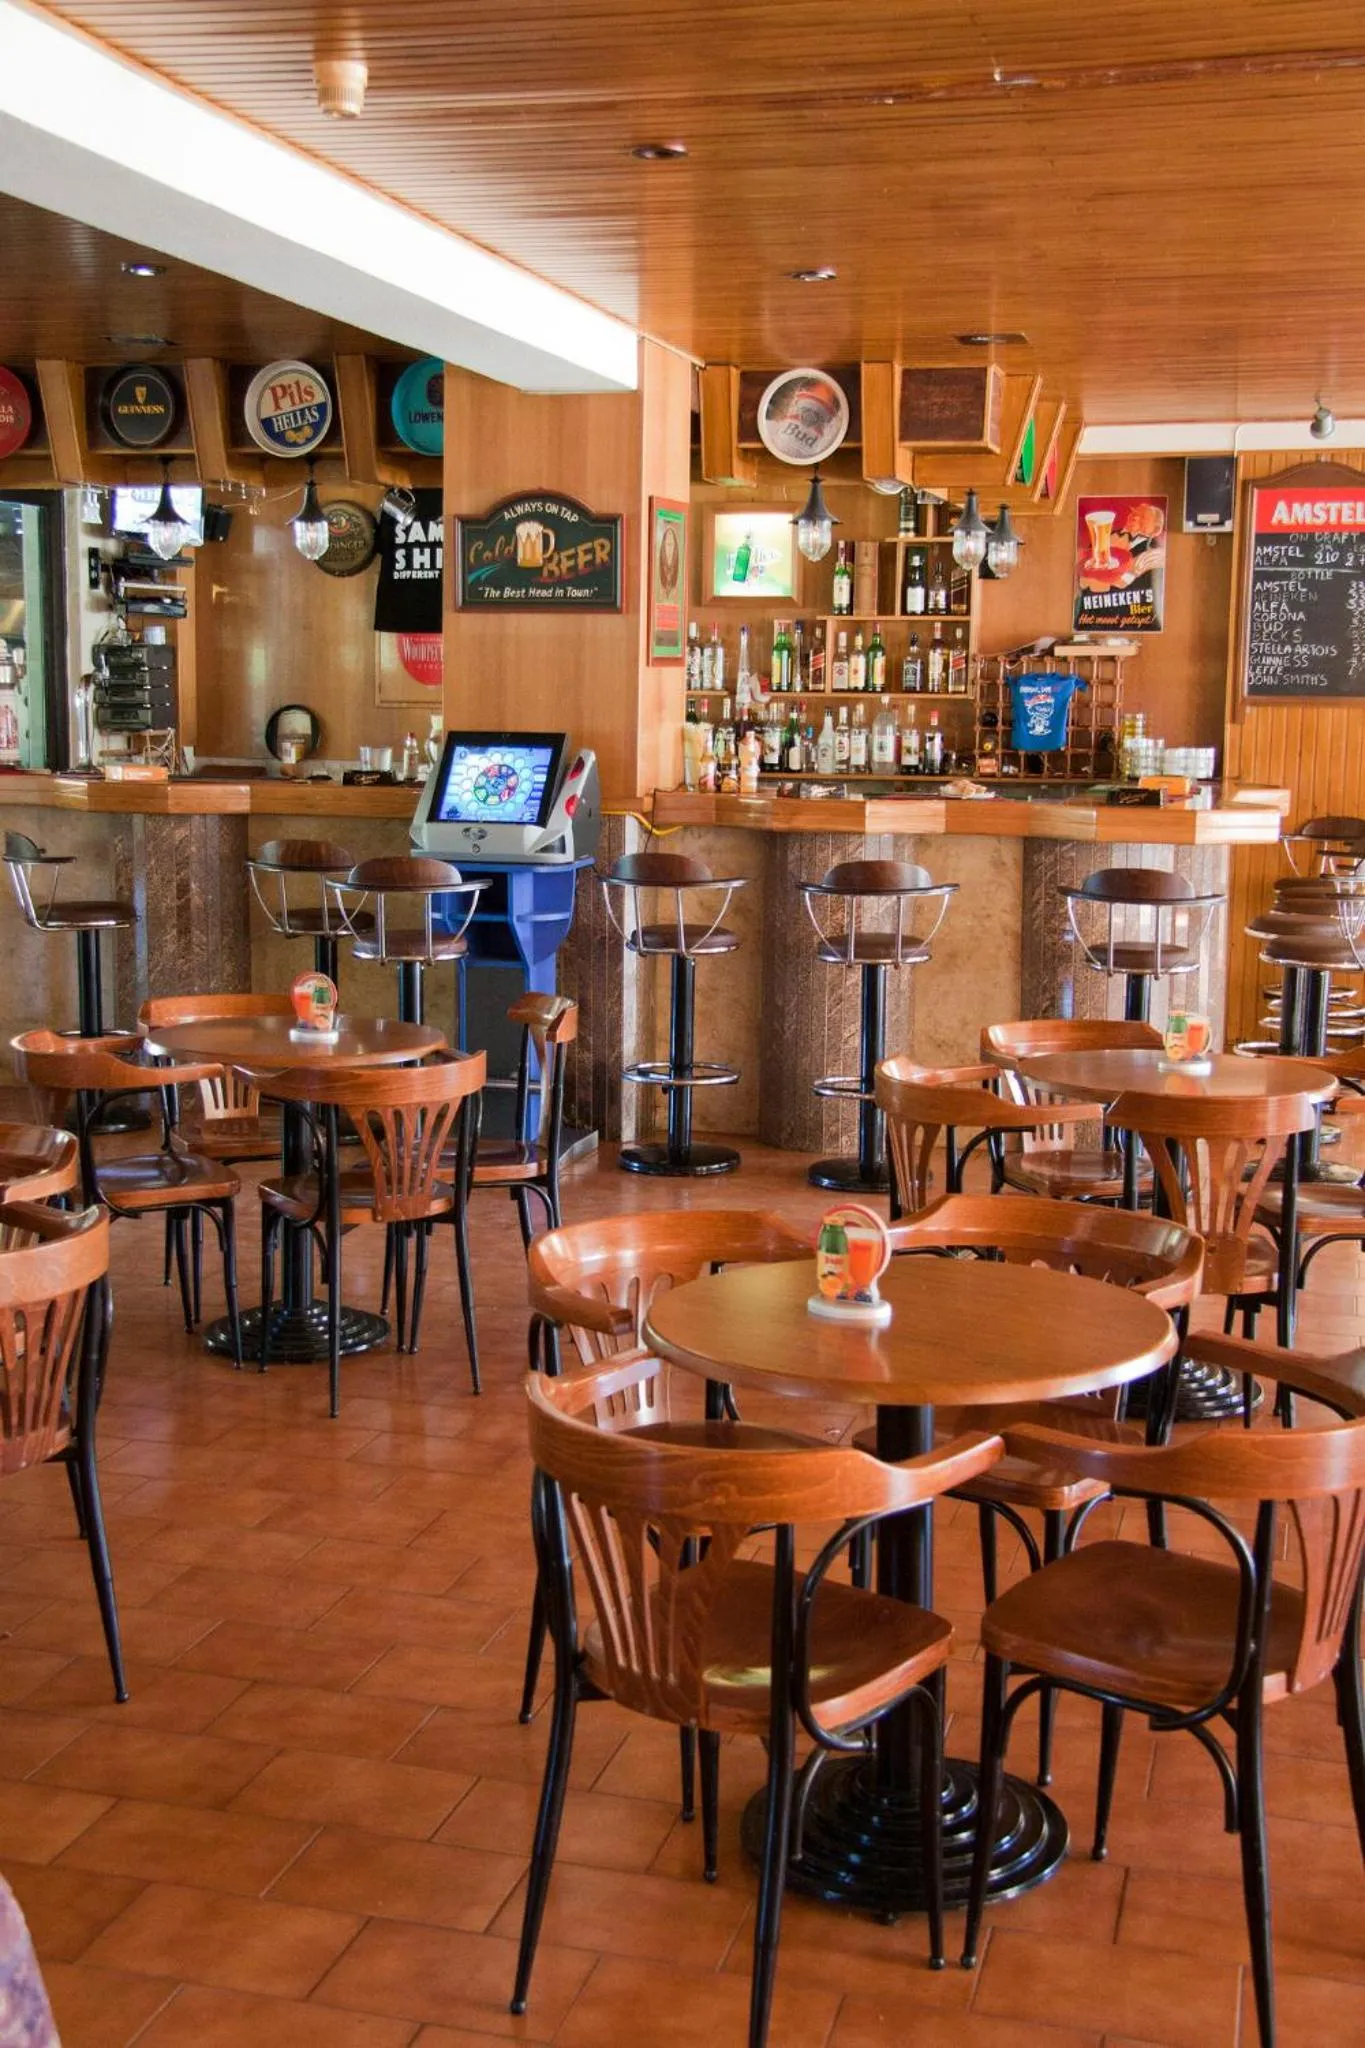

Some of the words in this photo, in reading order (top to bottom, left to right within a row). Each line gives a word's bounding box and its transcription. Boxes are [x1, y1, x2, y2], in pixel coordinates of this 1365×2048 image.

[269, 380, 315, 411] Pils
[118, 404, 165, 415] GUINNESS
[272, 406, 319, 433] HELLAS
[783, 422, 818, 447] Bud
[503, 501, 543, 521] ALWAYS
[545, 502, 560, 514] ON
[560, 506, 579, 523] TAP
[1270, 499, 1365, 527] AMSTEL
[394, 520, 443, 544] SAM
[469, 535, 517, 565] Cold
[542, 537, 611, 578] BEER
[1255, 545, 1305, 558] AMSTEL
[395, 548, 443, 570] SHI
[1255, 556, 1289, 566] ALFA
[393, 570, 440, 580] DIFFERENT
[503, 587, 526, 598] Best
[528, 587, 553, 598] Head
[555, 587, 564, 597] in
[1254, 581, 1309, 592] AMSTEL
[1083, 589, 1153, 610] HEINEKEN'S
[1129, 604, 1153, 615] Bier
[1252, 601, 1290, 613] ALFA
[1252, 611, 1307, 622] CORONA
[1253, 621, 1284, 633] BUD
[1250, 642, 1292, 655] STELLA
[1294, 643, 1338, 657] ARTOIS
